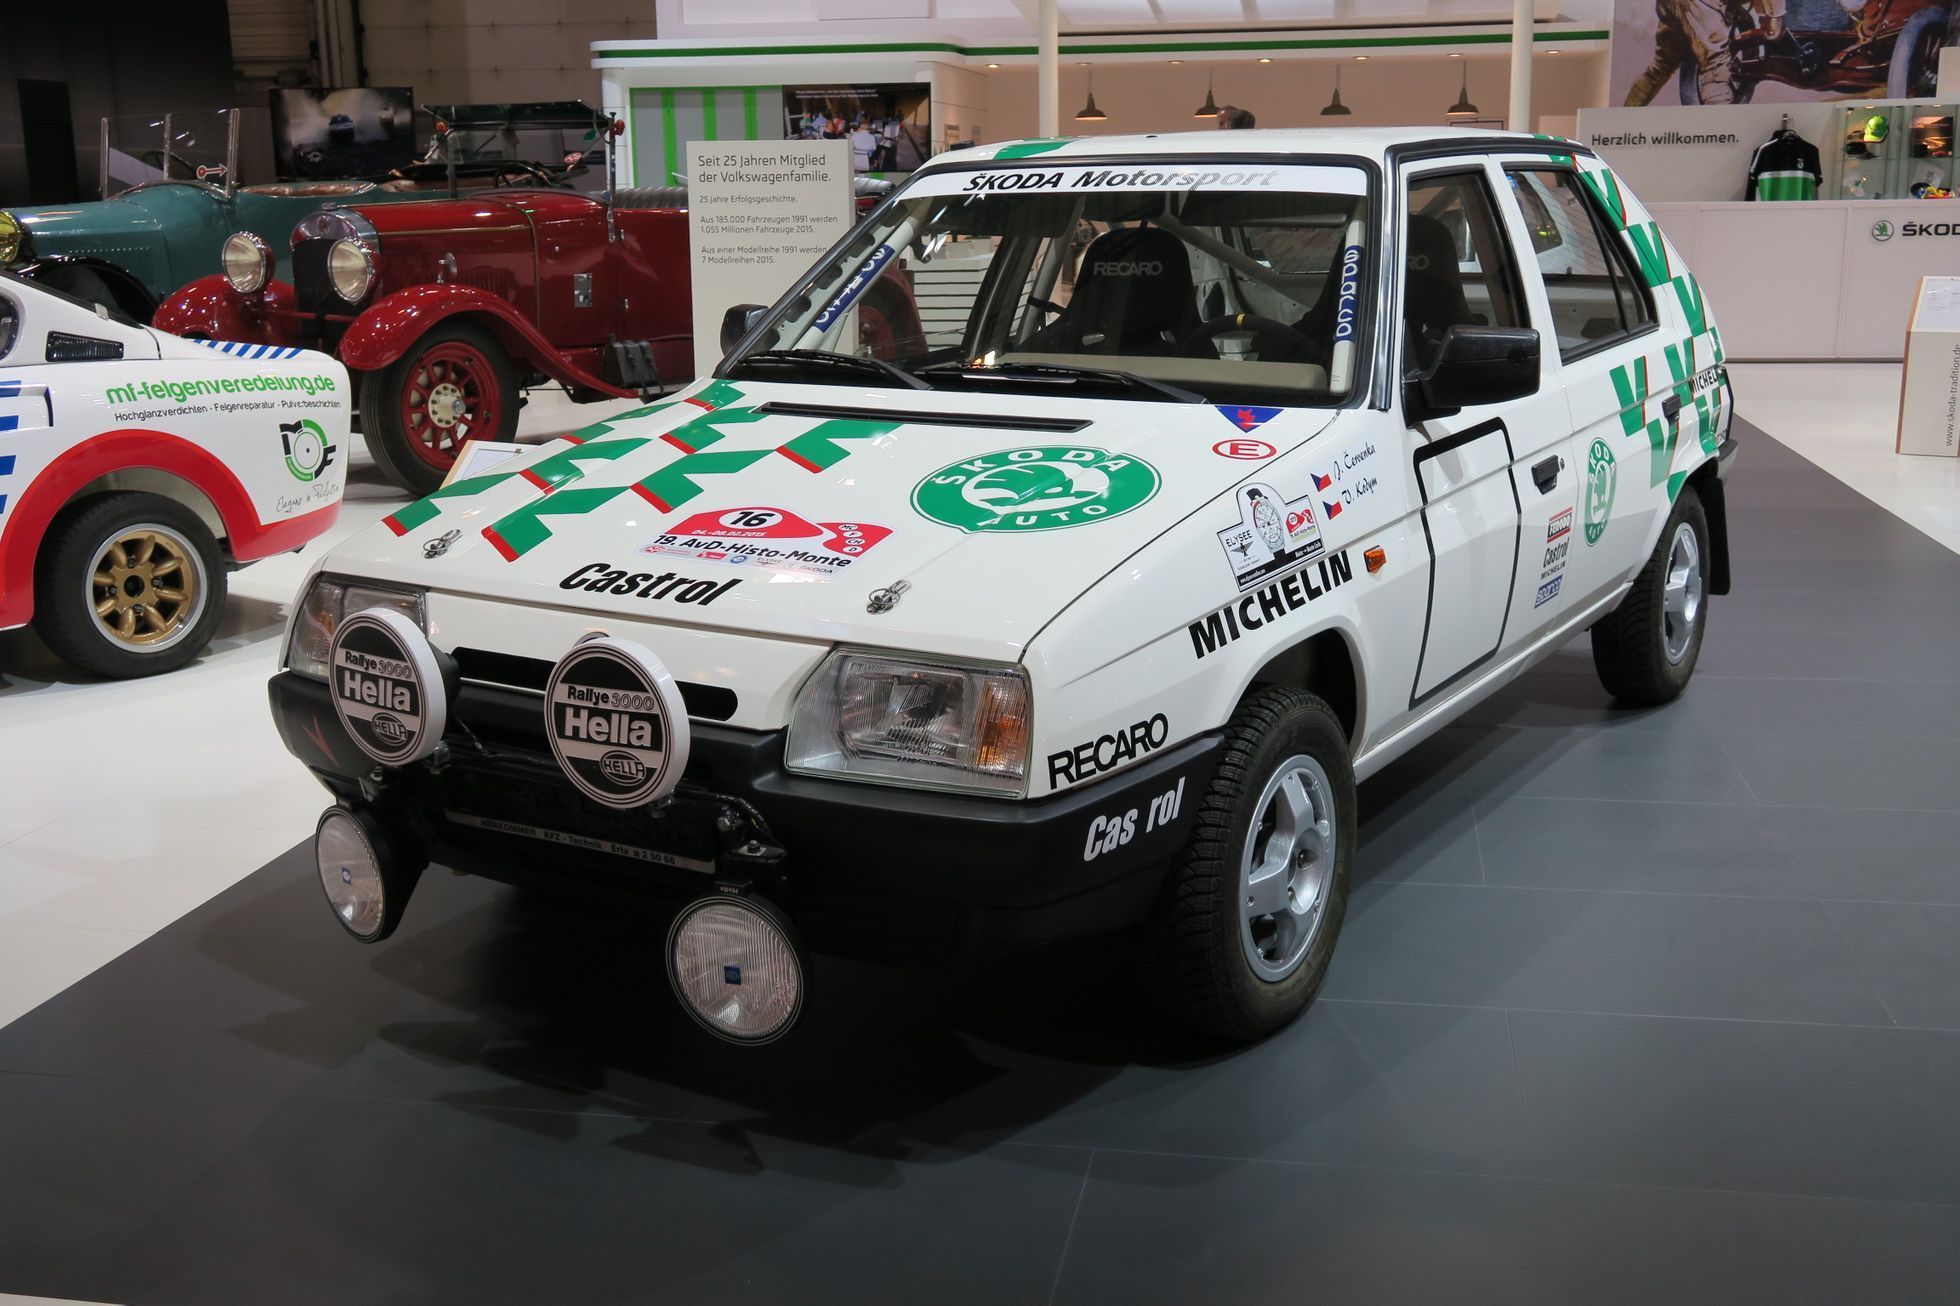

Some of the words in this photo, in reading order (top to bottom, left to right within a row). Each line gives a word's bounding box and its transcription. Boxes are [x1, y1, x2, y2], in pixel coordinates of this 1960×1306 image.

[1591, 132, 1647, 146] Herzlich
[1651, 131, 1740, 145] willkommen.
[698, 155, 720, 167] Seit
[723, 155, 737, 167] 25
[740, 155, 777, 168] Jahren
[780, 154, 826, 169] Mitglied
[699, 171, 717, 183] der
[720, 170, 832, 185] Volkswagenfamilie.
[963, 172, 1065, 192] ŠKODA
[1070, 169, 1280, 192] Motorsport
[699, 195, 709, 203] 25
[710, 195, 729, 204] Jahre
[730, 194, 797, 205] Erfolgsgeschichte.
[700, 216, 714, 224] Aus
[716, 215, 745, 224] 185.000
[747, 215, 790, 226] Fahrzeugen
[792, 215, 808, 223] 1991
[810, 215, 838, 223] werden
[700, 226, 720, 234] 1.055
[721, 225, 754, 234] Millionen
[755, 225, 795, 236] Fahrzeuge
[796, 225, 815, 234] 2015.
[701, 246, 715, 254] Aus
[717, 246, 736, 254] einer
[737, 246, 780, 254] Modellreihe
[782, 246, 798, 254] 1991
[799, 245, 827, 254] werden
[701, 256, 707, 264] 7
[708, 256, 755, 264] Modellreihen
[756, 256, 775, 264] 2015.
[1093, 260, 1163, 276] RECARO
[105, 374, 336, 404] mf-felgenveredelung.de
[114, 404, 208, 422] Hochglanzverdichten
[214, 401, 275, 412] Felgenreparatur
[1230, 443, 1260, 456] E
[931, 450, 1132, 485] ŠKODA
[729, 511, 776, 527] 16
[976, 505, 1107, 526] AUTO
[1225, 529, 1253, 547] ELYSEE
[653, 535, 675, 547] 19.
[680, 537, 853, 567] AvD-Histo-Monte
[1543, 537, 1569, 568] Castrol
[1541, 560, 1566, 580] MICHELIN
[560, 563, 744, 606] Castrol
[1188, 549, 1353, 659] MICHELIN
[345, 650, 377, 671] Rallye
[378, 661, 412, 679] 3000
[344, 670, 411, 712] Hella
[567, 685, 610, 706] Rallye
[611, 692, 655, 711] 3000
[374, 721, 407, 741] HELLA
[564, 705, 652, 747] Hella
[1047, 713, 1168, 790] RECARO
[603, 760, 645, 778] HELLA
